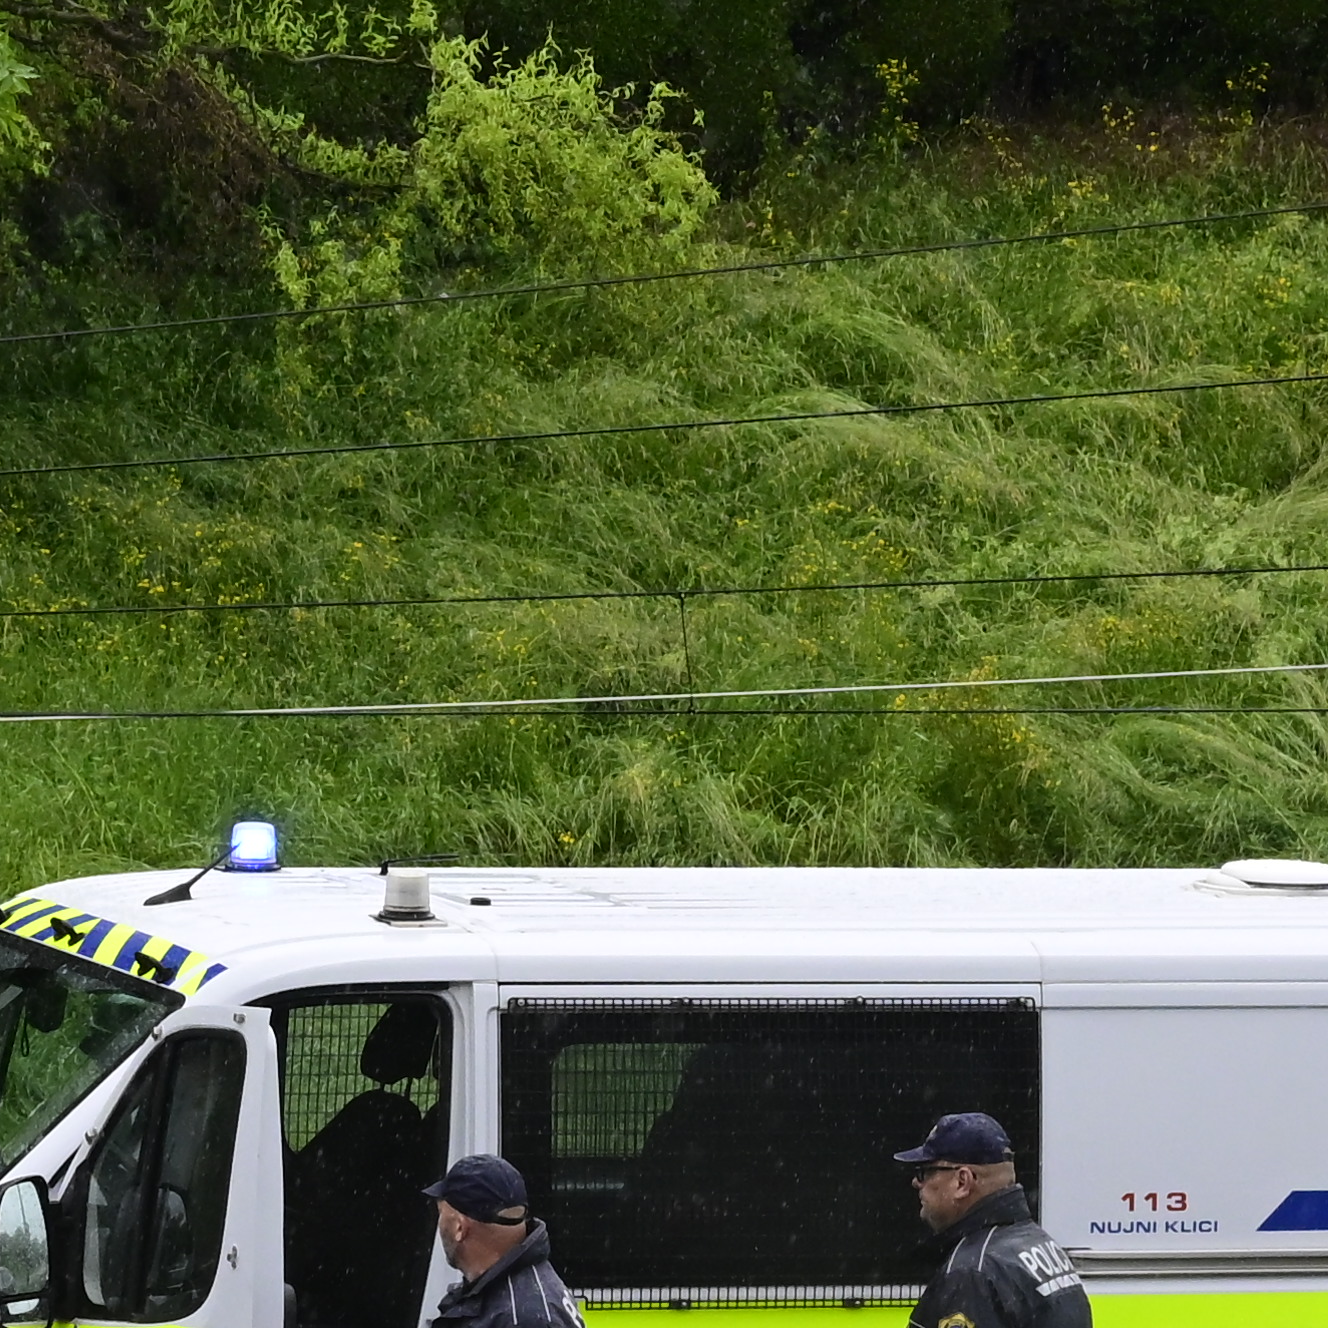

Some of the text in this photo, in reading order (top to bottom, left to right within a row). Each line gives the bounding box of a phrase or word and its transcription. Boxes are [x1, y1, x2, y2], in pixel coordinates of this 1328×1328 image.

[1121, 1192, 1188, 1212] 113
[1090, 1221, 1218, 1233] NUJNI KLICI
